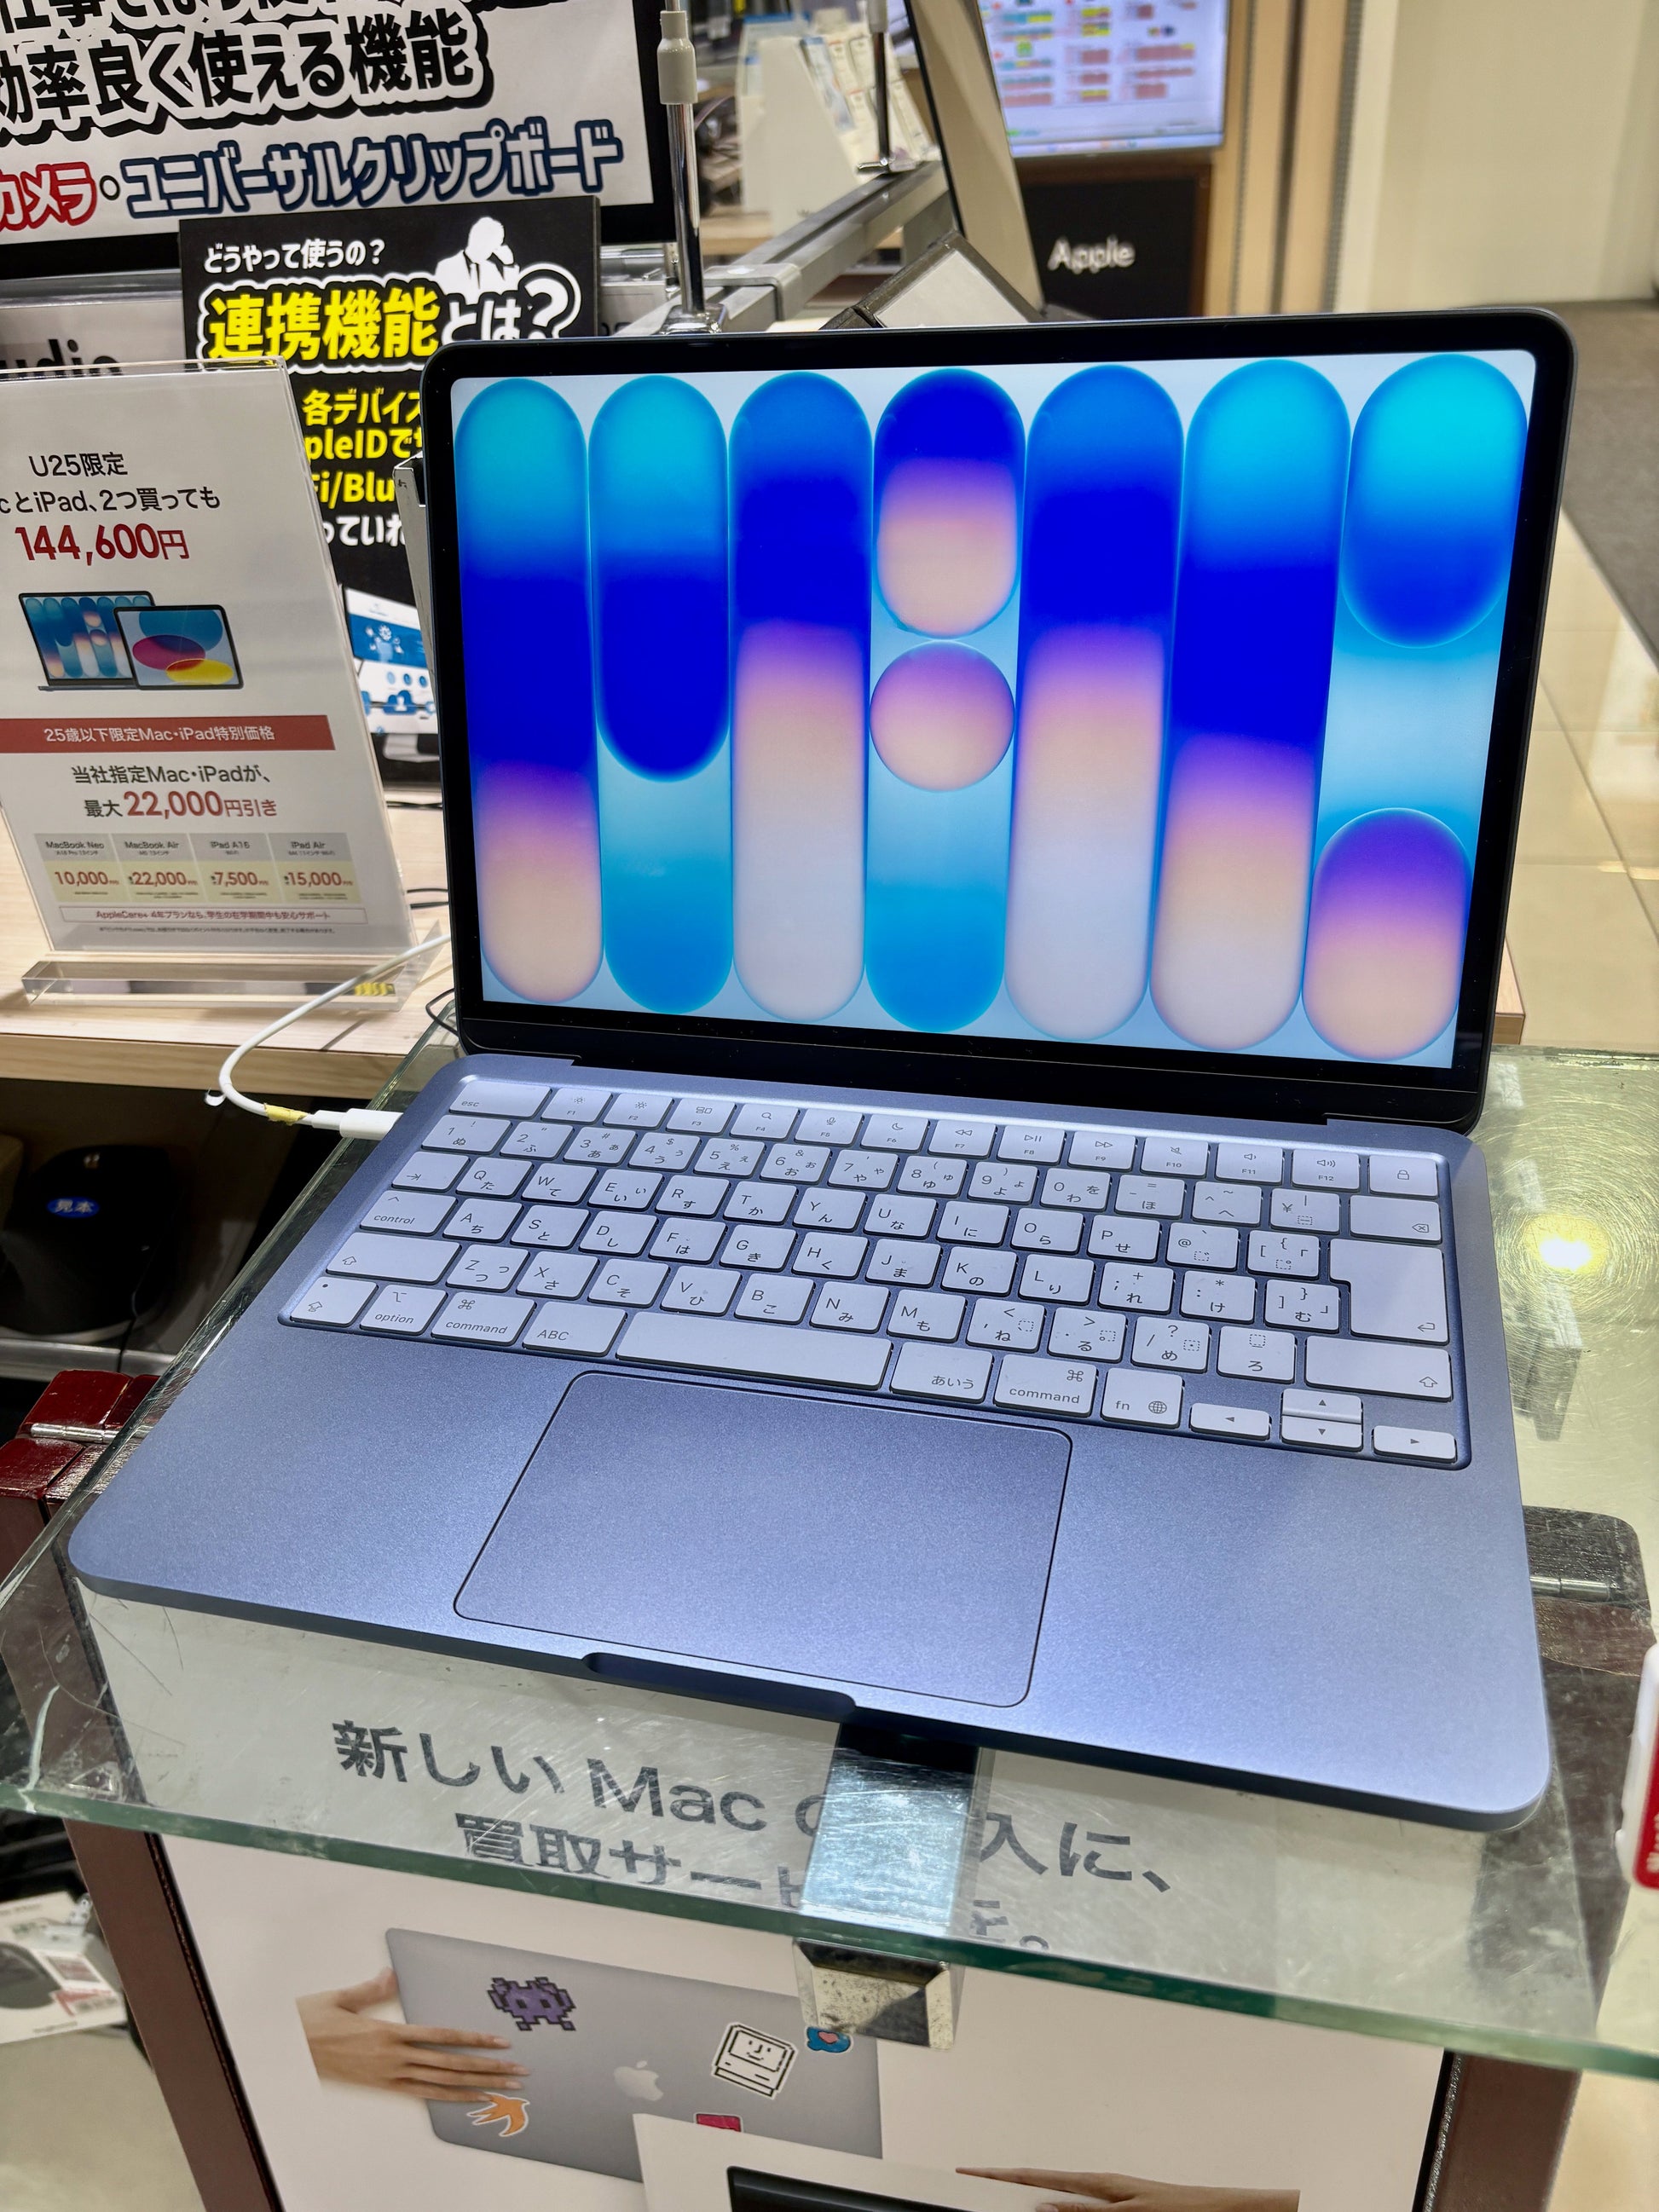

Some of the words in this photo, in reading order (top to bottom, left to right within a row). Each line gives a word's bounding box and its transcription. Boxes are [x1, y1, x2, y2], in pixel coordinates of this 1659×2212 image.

[1047, 235, 1136, 274] Apple
[28, 452, 128, 477] U25限定
[14, 523, 190, 566] 144,600円
[45, 840, 85, 850] MacBook
[87, 840, 105, 850] Neo
[124, 840, 165, 850] MacBook
[167, 840, 180, 850] Air
[210, 840, 230, 850] iPad
[290, 840, 311, 850] iPad
[516, 1133, 529, 1143] 2
[523, 1144, 537, 1153] ふ
[580, 1139, 592, 1149] 3
[644, 1145, 656, 1154] 4
[587, 1149, 602, 1159] あ
[654, 1155, 666, 1164] う
[709, 1150, 721, 1160] 5
[718, 1161, 731, 1171] え
[775, 1156, 787, 1166] 6
[784, 1167, 800, 1177] お
[843, 1162, 854, 1172] 7
[473, 1170, 487, 1181] Q
[853, 1174, 867, 1183] や
[910, 1169, 922, 1179] 8
[538, 1175, 556, 1187] W
[922, 1180, 936, 1190] ゆ
[981, 1175, 992, 1185] 9
[480, 1181, 495, 1191] た
[604, 1181, 618, 1193] E
[993, 1187, 1008, 1196] よ
[1086, 1185, 1101, 1195] を
[549, 1188, 562, 1197] て
[671, 1188, 685, 1198] R
[1066, 1193, 1082, 1203] わ
[683, 1200, 697, 1210] す
[741, 1194, 753, 1205] T
[1142, 1200, 1157, 1210] ほ
[748, 1206, 764, 1216] か
[810, 1201, 822, 1211] Y
[460, 1212, 472, 1223] A
[818, 1213, 833, 1223] ん
[878, 1208, 892, 1219] U
[373, 1215, 416, 1225] control
[528, 1219, 542, 1230] S
[890, 1220, 905, 1231] な
[471, 1224, 484, 1234] ち
[596, 1225, 610, 1236] D
[963, 1227, 978, 1238] に
[1101, 1229, 1113, 1240] P
[537, 1231, 551, 1241] と
[666, 1232, 679, 1243] F
[1038, 1234, 1051, 1245] ら
[606, 1237, 619, 1248] し
[736, 1239, 749, 1250] G
[1177, 1238, 1192, 1248] @
[675, 1245, 691, 1255] は
[806, 1246, 822, 1259] H
[1115, 1243, 1131, 1254] せ
[747, 1252, 761, 1262] き
[881, 1255, 893, 1266] J
[464, 1259, 480, 1271] Z
[821, 1260, 833, 1271] く
[956, 1262, 969, 1274] K
[534, 1266, 550, 1279] X
[893, 1268, 908, 1278] ま
[1034, 1270, 1044, 1283] L
[544, 1279, 560, 1291] さ
[606, 1274, 621, 1285] C
[968, 1276, 985, 1286] の
[680, 1281, 694, 1293] V
[1049, 1284, 1061, 1295] り
[616, 1288, 631, 1298] そ
[751, 1289, 765, 1302] B
[1125, 1292, 1143, 1304] れ
[689, 1296, 705, 1306] ひ
[825, 1297, 841, 1310] N
[762, 1303, 777, 1314] こ
[900, 1305, 918, 1319] M
[1210, 1302, 1226, 1314] け
[374, 1314, 414, 1324] option
[838, 1312, 854, 1323] み
[1295, 1311, 1312, 1323] む
[445, 1321, 508, 1334] command
[916, 1320, 931, 1332] も
[1167, 1325, 1179, 1337] ?
[536, 1329, 569, 1341] ABC
[994, 1330, 1011, 1342] ね
[1078, 1340, 1092, 1352] る
[1161, 1349, 1178, 1361] め
[1247, 1360, 1263, 1372] ろ
[931, 1375, 974, 1389] あいう
[1009, 1388, 1080, 1404] command
[1115, 1400, 1130, 1411] fn
[332, 1720, 565, 1794] 新しい
[587, 1758, 767, 1832] Mac
